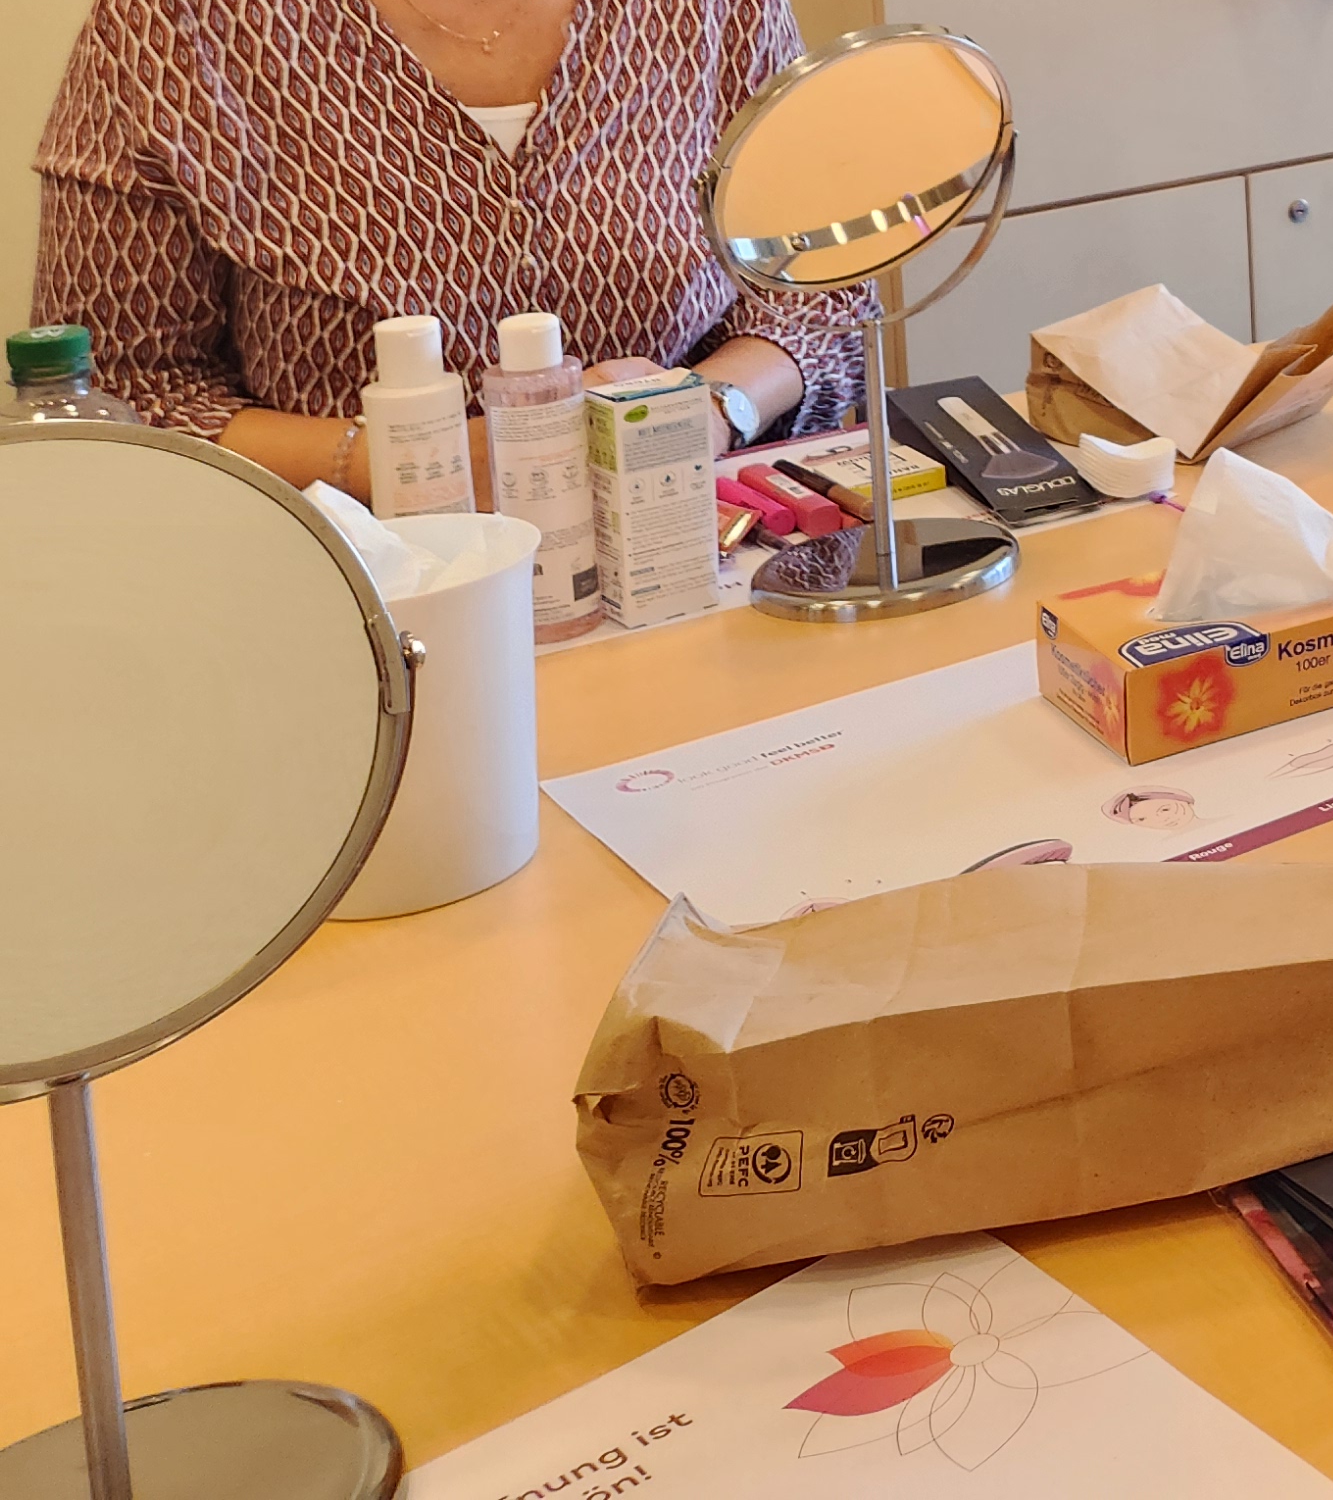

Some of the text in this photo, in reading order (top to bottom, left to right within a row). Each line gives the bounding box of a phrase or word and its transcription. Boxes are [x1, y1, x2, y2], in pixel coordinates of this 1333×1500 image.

[996, 475, 1077, 498] DOUGLAS
[1295, 654, 1330, 673] 100er
[760, 744, 793, 759] feel
[794, 729, 845, 748] better
[1188, 841, 1235, 862] Rouge
[653, 1118, 696, 1167] 100%
[737, 1145, 750, 1188] PEFC
[498, 1413, 694, 1500] nung ist
